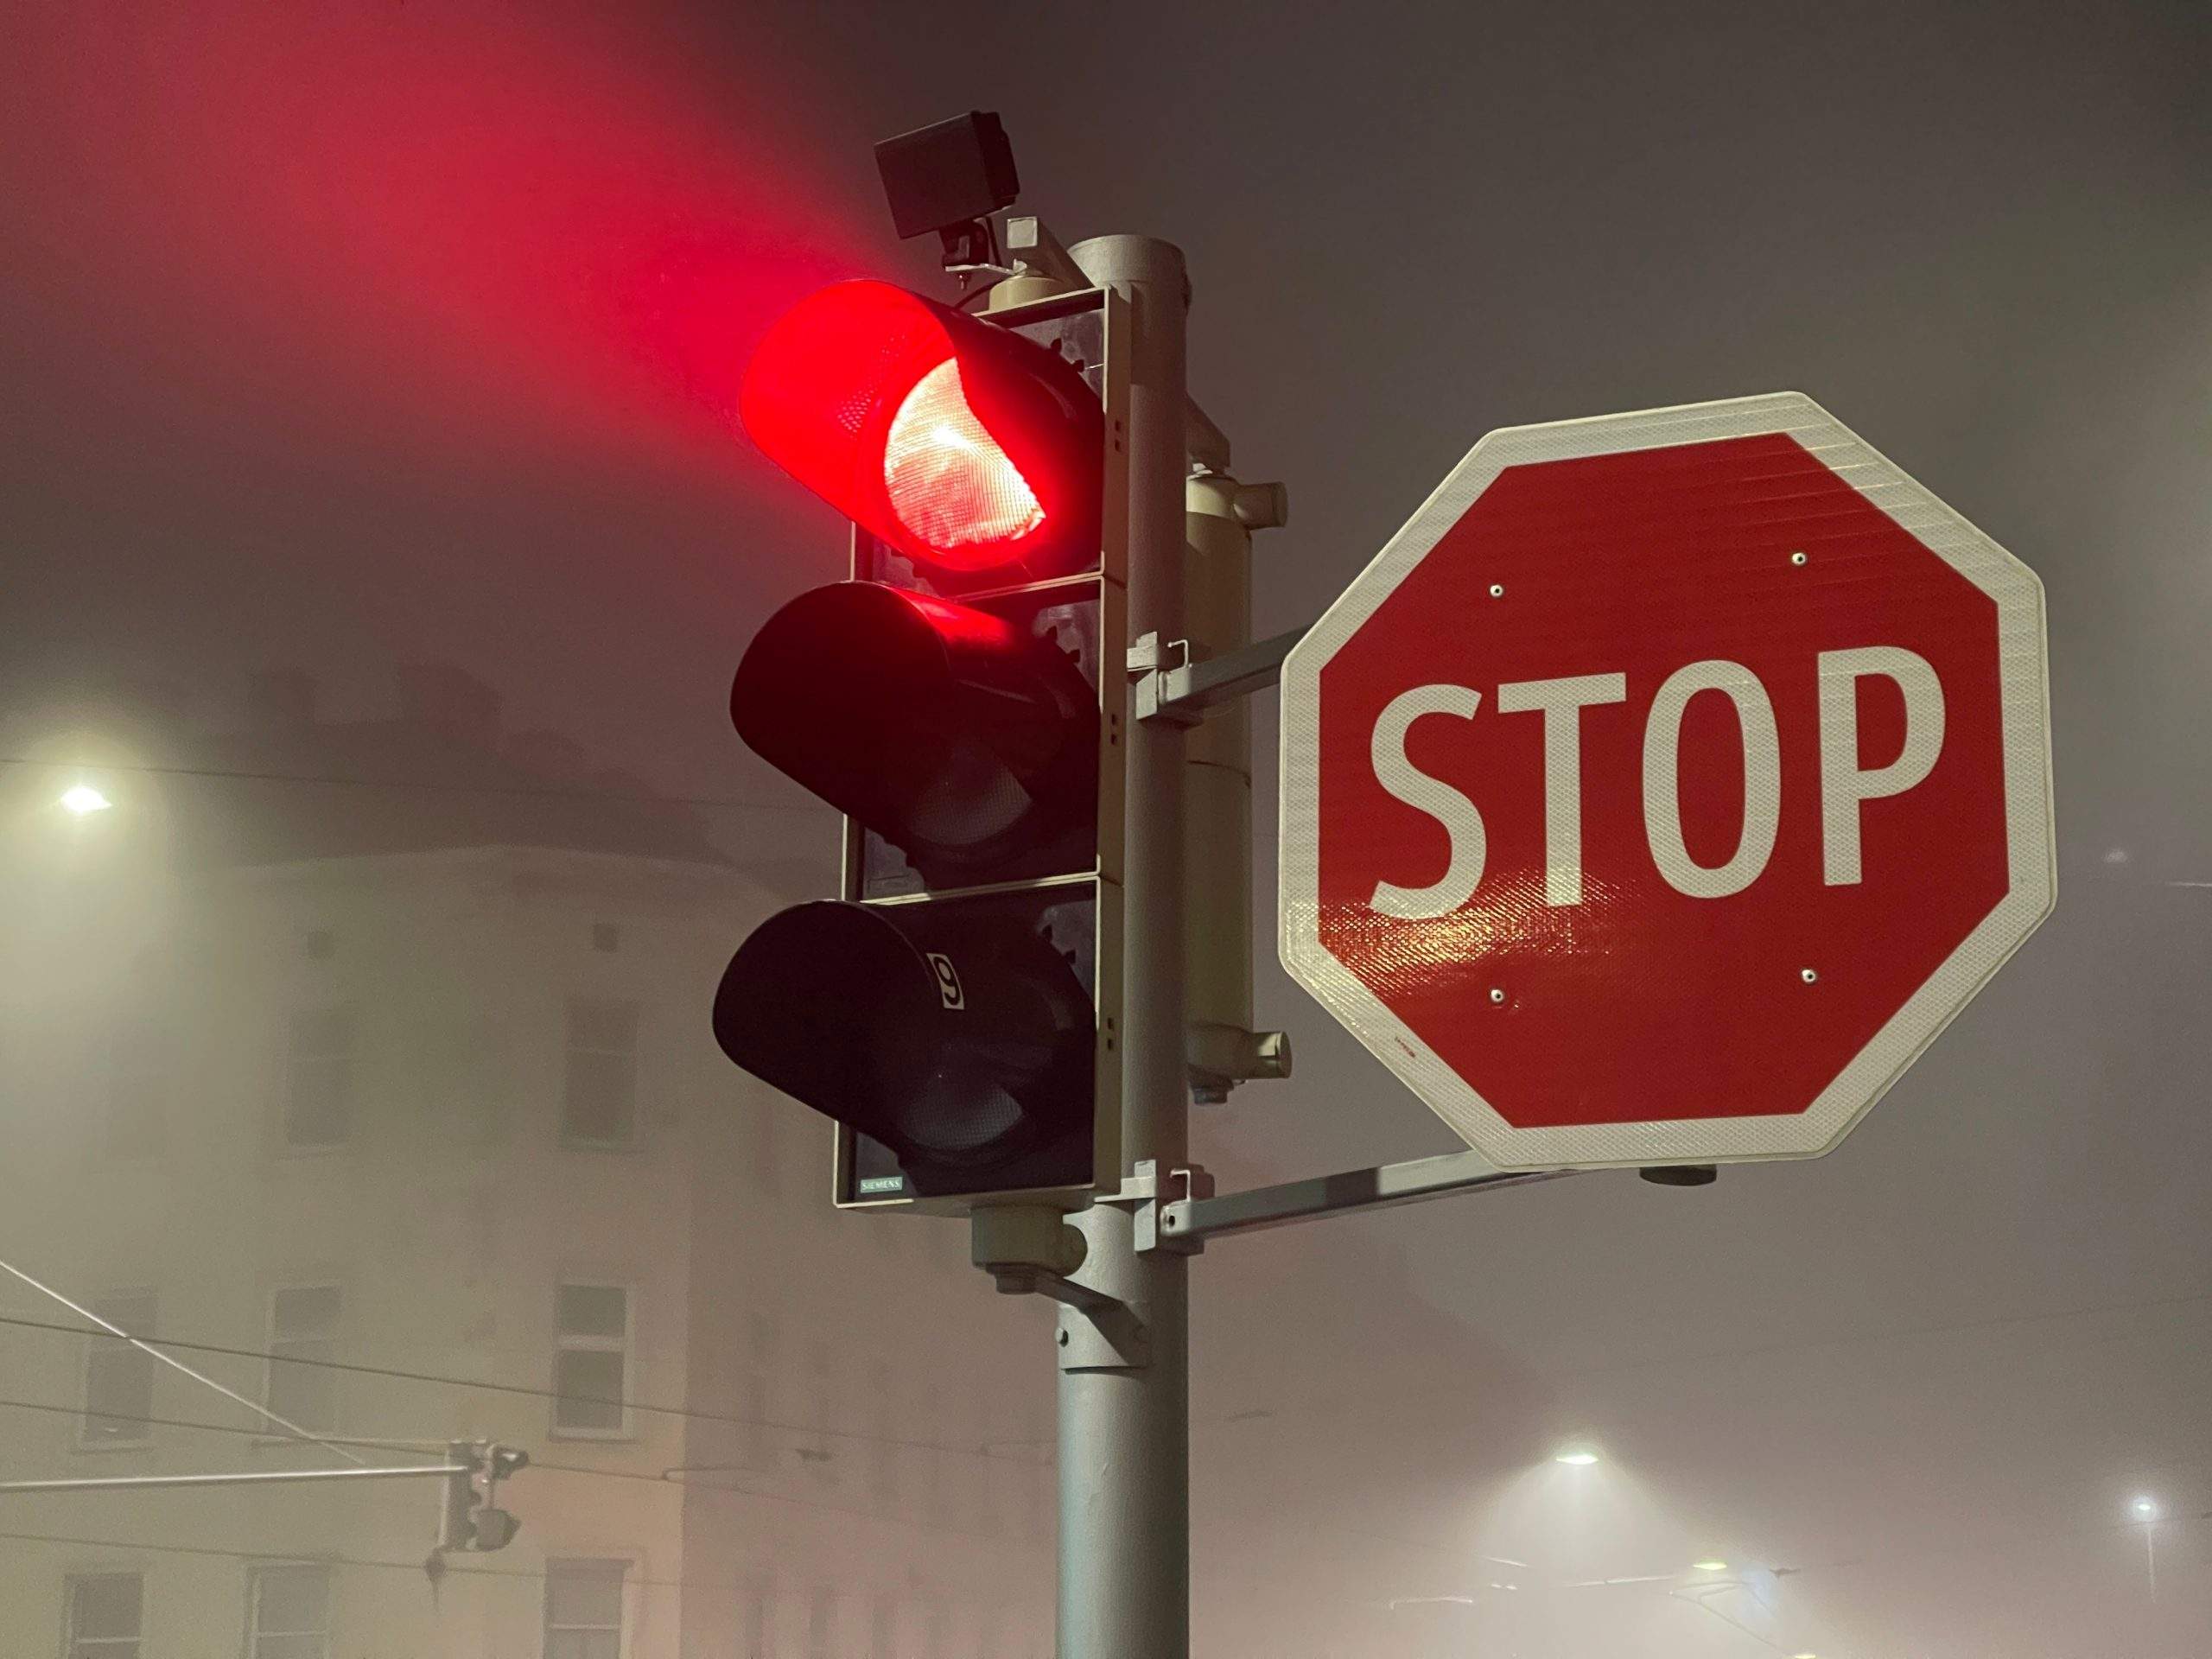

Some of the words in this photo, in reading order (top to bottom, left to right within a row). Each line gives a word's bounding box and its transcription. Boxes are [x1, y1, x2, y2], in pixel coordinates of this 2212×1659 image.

[1368, 645, 1946, 919] STOP
[933, 957, 961, 1006] 9
[861, 1179, 901, 1191] SIEMENS
